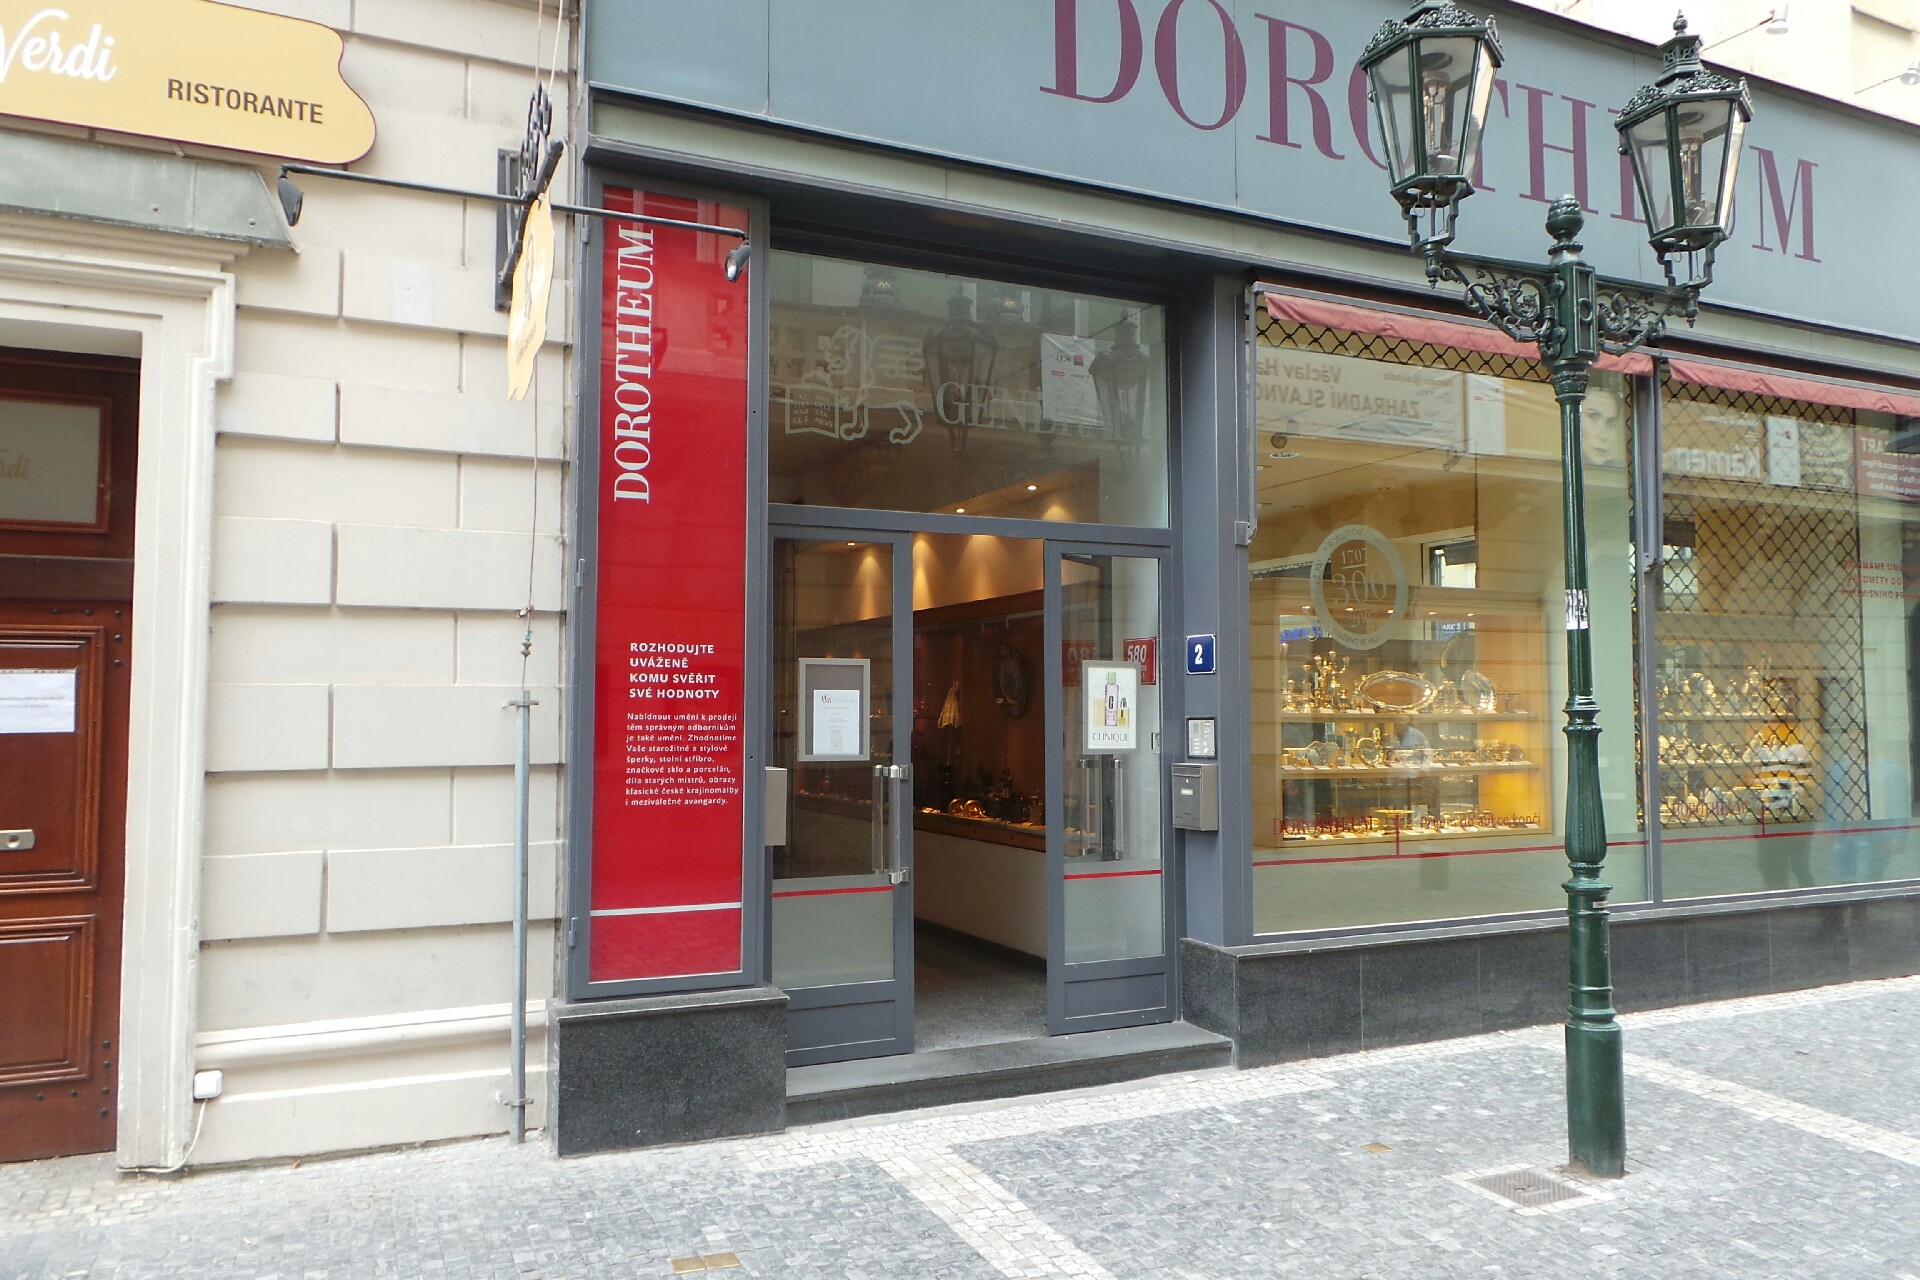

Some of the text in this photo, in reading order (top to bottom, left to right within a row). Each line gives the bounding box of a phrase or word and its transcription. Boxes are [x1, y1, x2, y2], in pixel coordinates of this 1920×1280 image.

[167, 78, 324, 125] RISTORANTE
[614, 224, 654, 504] DOROTHEUM
[630, 642, 715, 655] ROZHODUJTE
[1127, 644, 1147, 663] 580
[1194, 643, 1203, 665] 2
[629, 656, 689, 668] UVÁŽENĚ
[629, 672, 716, 684] KOMU SVĚŘIT
[629, 687, 720, 699] SVÉ HODNOTY
[673, 713, 699, 721] umění
[708, 713, 737, 722] prodeji
[645, 723, 685, 732] správným
[687, 723, 736, 731] odborníkům
[637, 734, 655, 742] také
[1092, 732, 1130, 742] CLINIQUE
[626, 744, 646, 752] Vaše
[648, 744, 690, 752] starožitné
[699, 744, 728, 753] stylové
[626, 755, 656, 764] šperky,
[659, 755, 682, 763] stolní
[625, 766, 665, 774] značkové
[667, 765, 684, 773] sklo
[693, 765, 731, 774] porcelán,
[625, 777, 642, 785] díla
[644, 777, 675, 785] starých
[708, 776, 736, 784] obrazy
[625, 787, 739, 796] klasické české krajinomalby
[631, 798, 682, 806] meziválečné
[1478, 813, 1509, 827] aukce
[1512, 812, 1541, 825] končí
